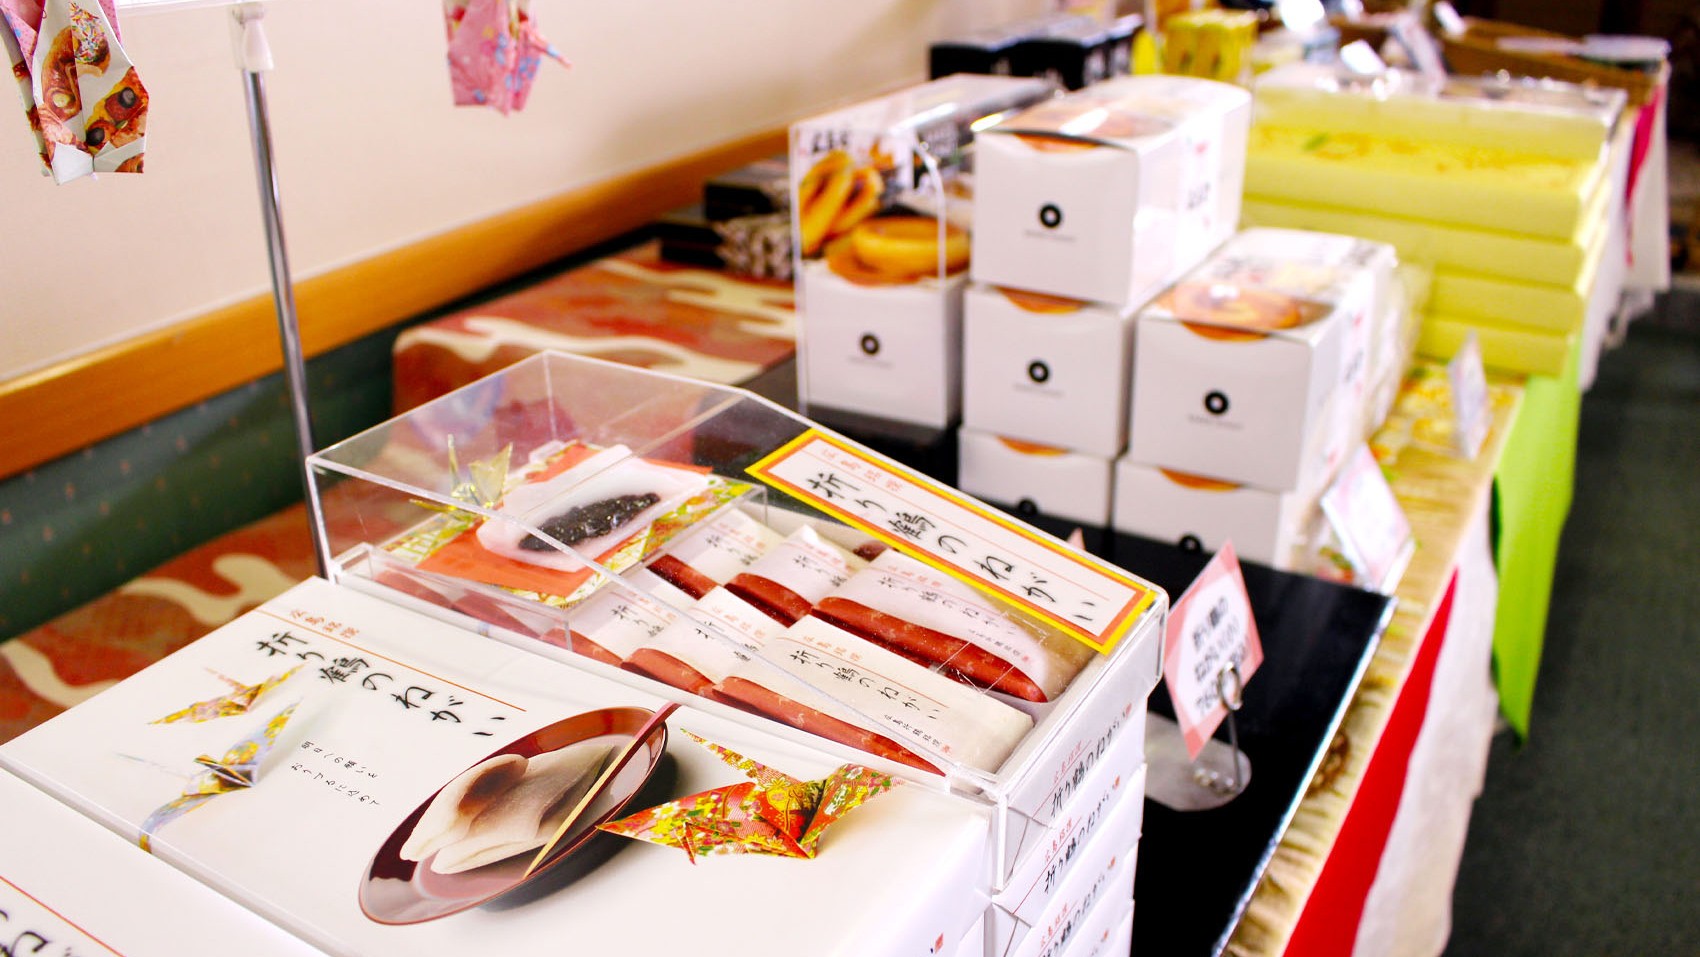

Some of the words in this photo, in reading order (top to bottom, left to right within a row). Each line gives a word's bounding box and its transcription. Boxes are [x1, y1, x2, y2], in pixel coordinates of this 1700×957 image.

[805, 471, 1097, 623] 折り鶴のねがい
[256, 630, 506, 738] 折り鶴のねがい
[789, 649, 940, 720] 折り鶴のねがい
[1051, 715, 1120, 819] 折り鶴のねがい
[1043, 789, 1110, 895] 折り鶴のねがい
